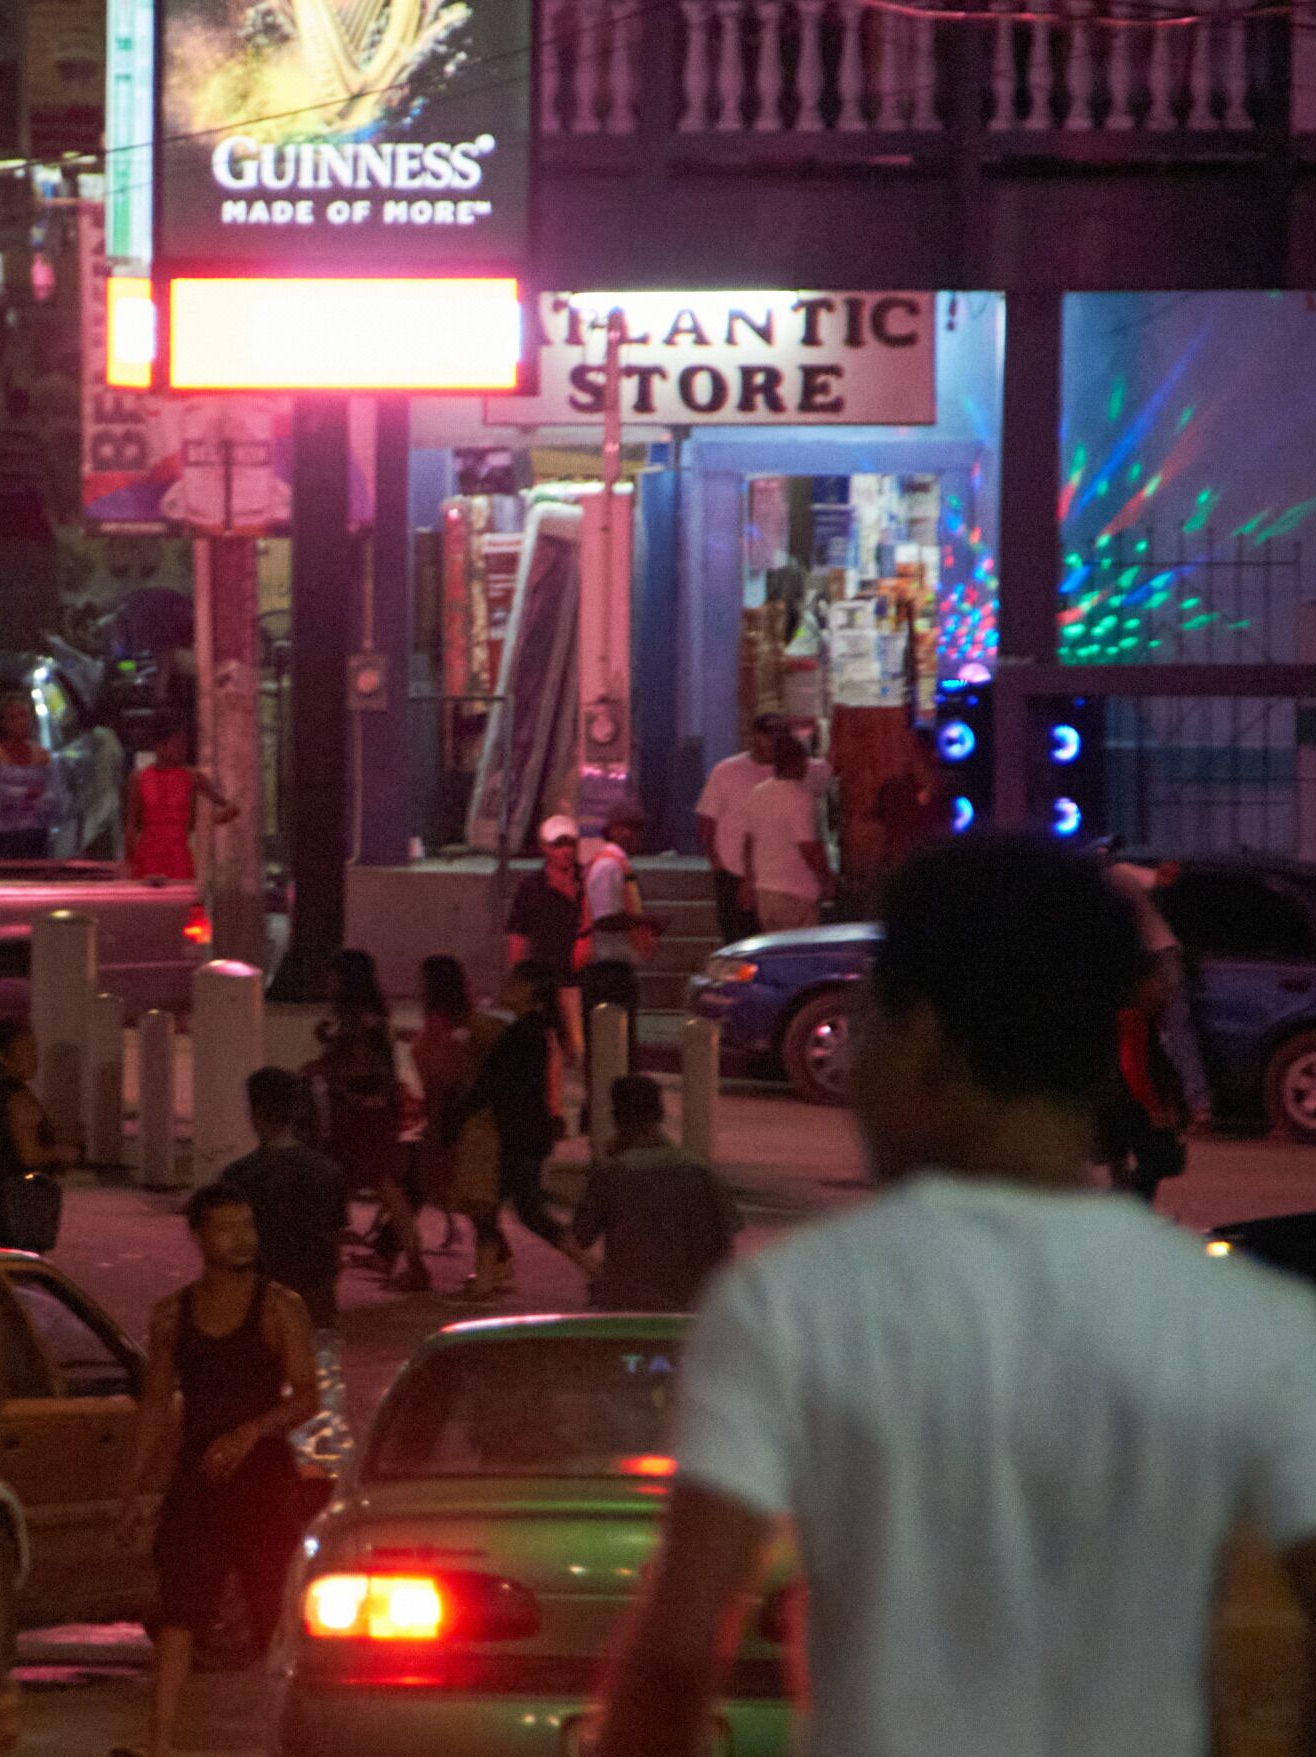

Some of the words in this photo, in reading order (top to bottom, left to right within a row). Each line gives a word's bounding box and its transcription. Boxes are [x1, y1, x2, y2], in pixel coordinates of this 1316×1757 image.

[221, 200, 314, 224] MADE
[326, 200, 371, 224] OF
[568, 363, 845, 414] STORE
[620, 1353, 674, 1376] TA
